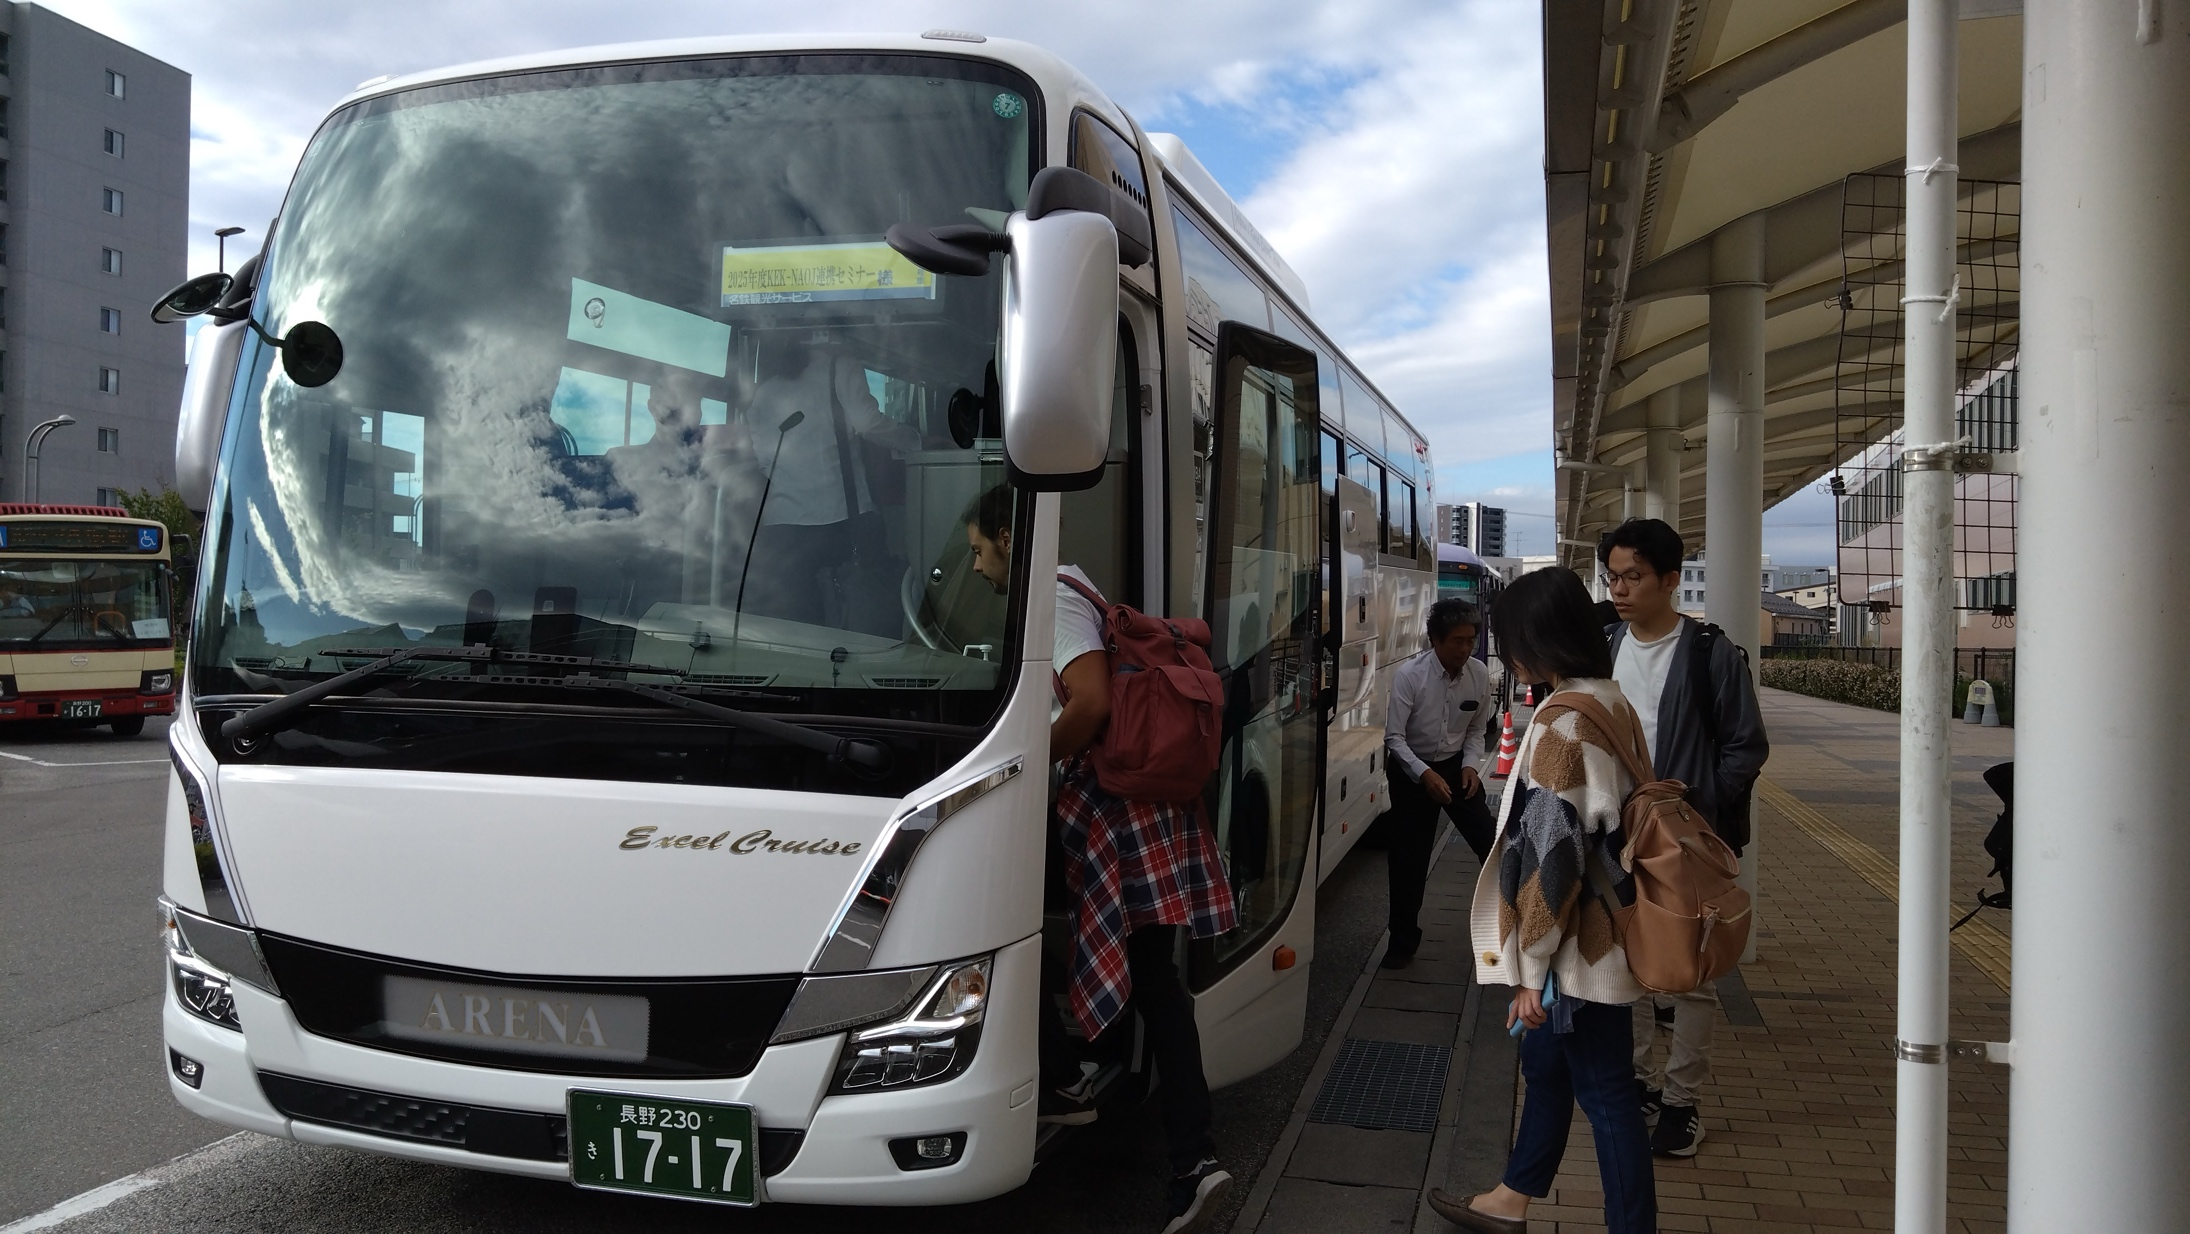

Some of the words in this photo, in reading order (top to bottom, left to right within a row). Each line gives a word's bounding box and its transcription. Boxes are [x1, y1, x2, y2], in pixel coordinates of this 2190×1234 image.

[618, 825, 731, 851] Excel
[728, 829, 862, 855] Cruise
[420, 988, 608, 1048] ARENA
[620, 1104, 701, 1131] 長野230
[613, 1127, 742, 1192] 17-17
